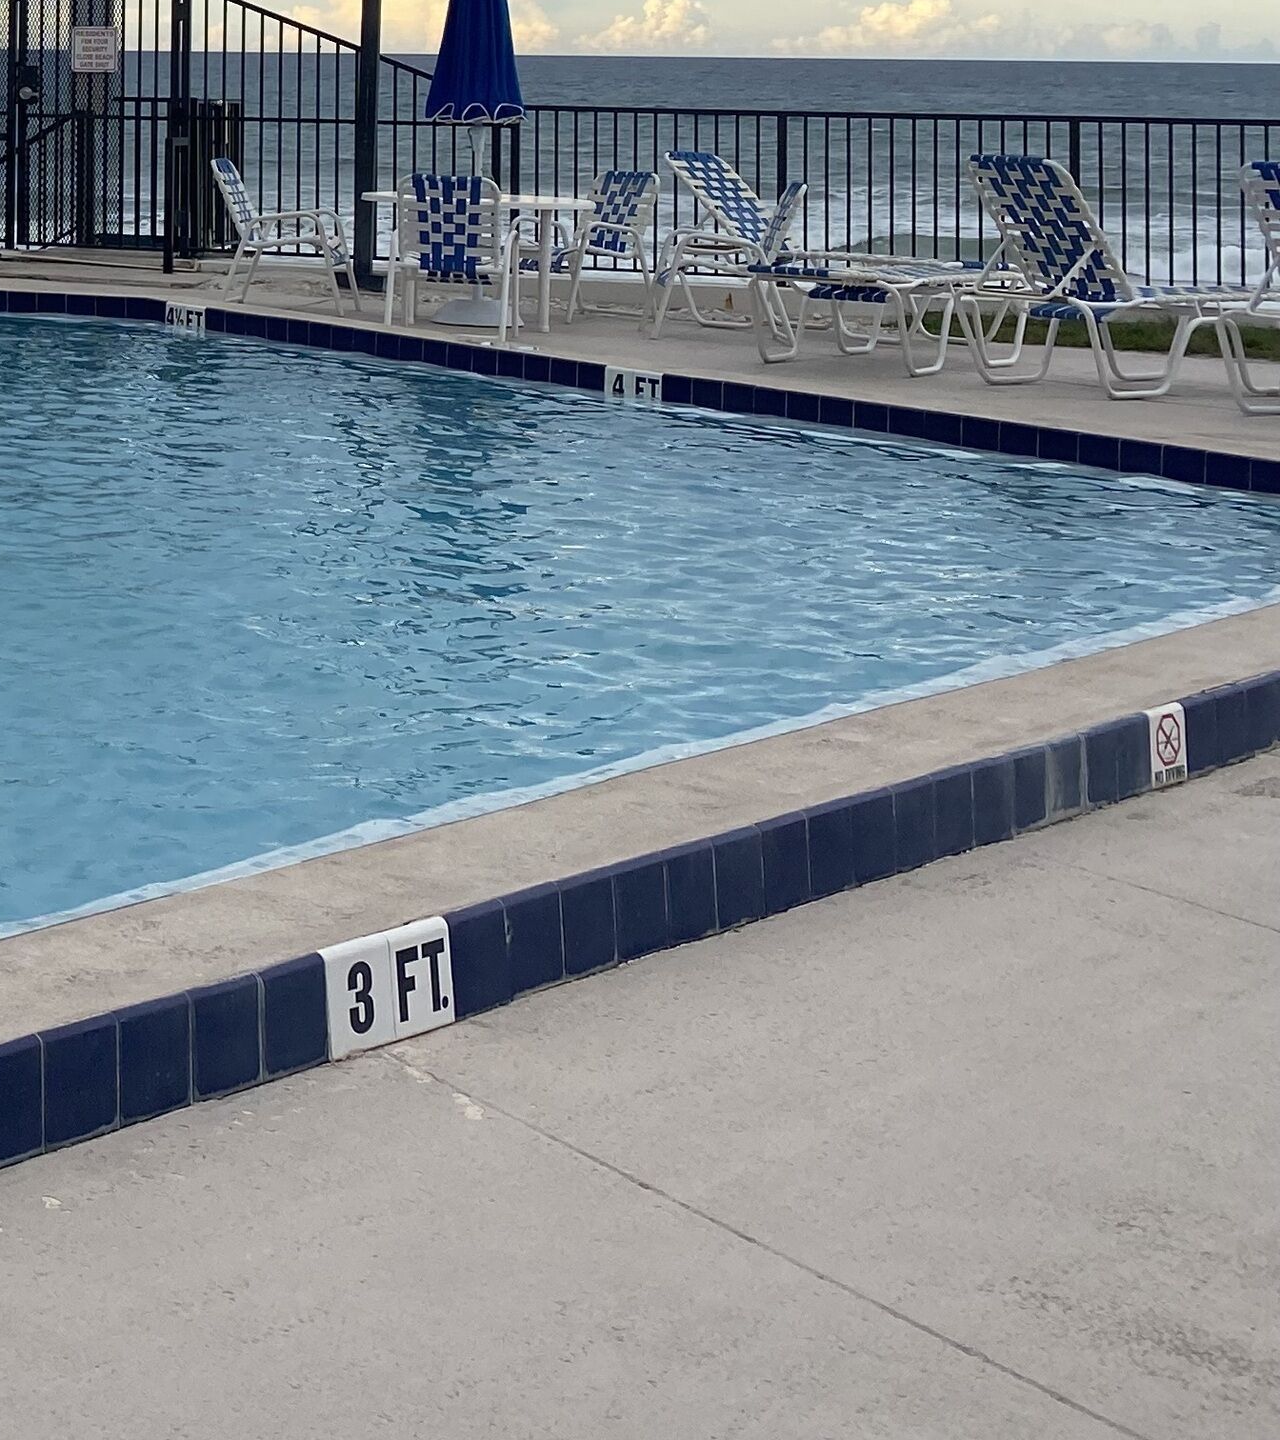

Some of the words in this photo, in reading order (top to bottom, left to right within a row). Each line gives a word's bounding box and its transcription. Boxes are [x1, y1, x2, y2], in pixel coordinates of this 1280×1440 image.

[612, 373, 625, 395] 4
[635, 376, 660, 398] FT
[347, 961, 375, 1034] 3
[395, 937, 449, 1023] FT.
